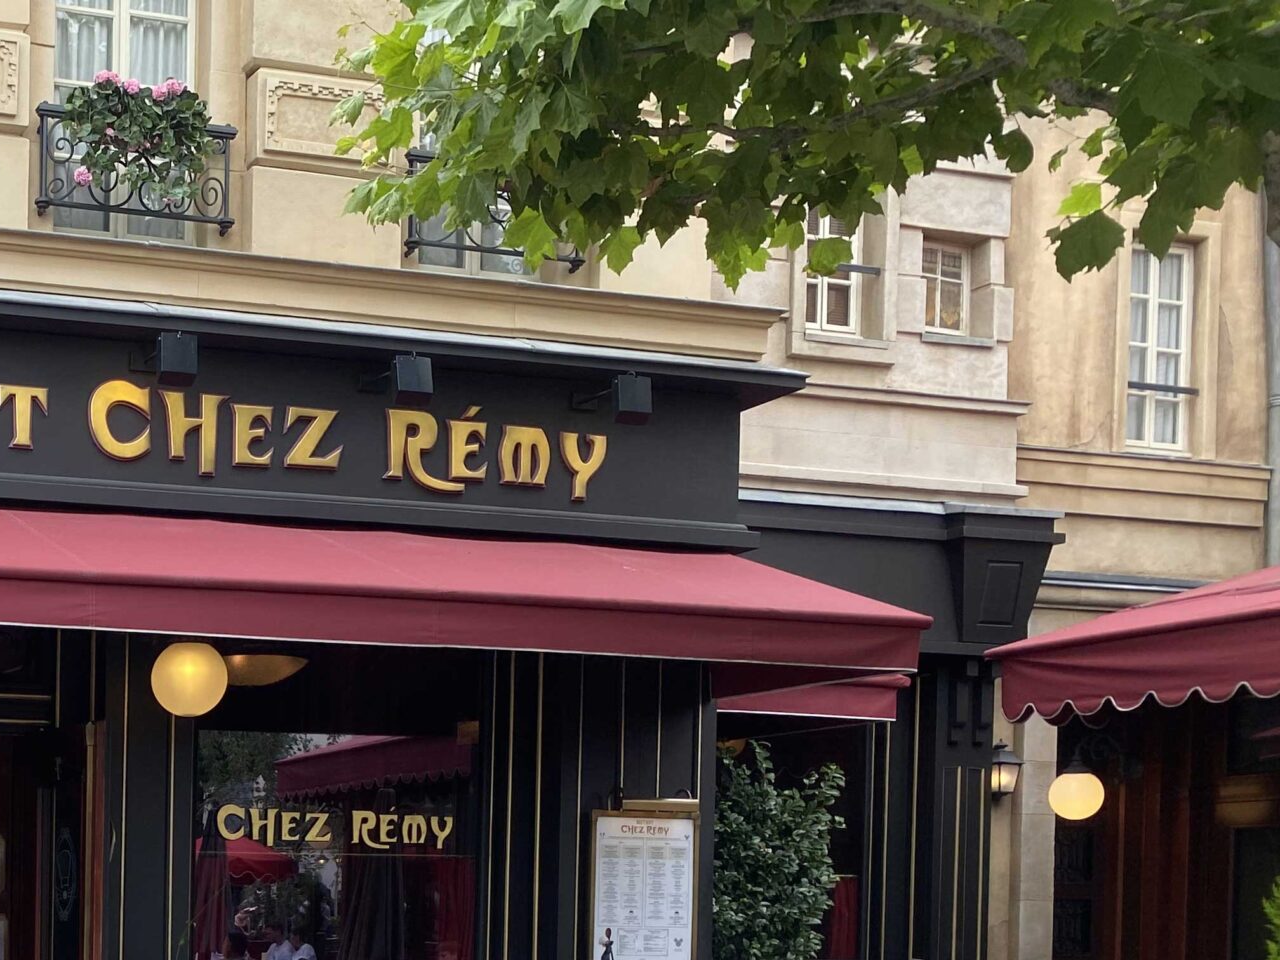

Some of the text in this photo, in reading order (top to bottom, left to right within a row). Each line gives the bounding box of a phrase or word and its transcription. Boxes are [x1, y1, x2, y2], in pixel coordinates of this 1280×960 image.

[88, 378, 344, 477] CHEZ
[381, 405, 608, 502] RÉMY
[216, 804, 454, 850] CHEZ RÉMY
